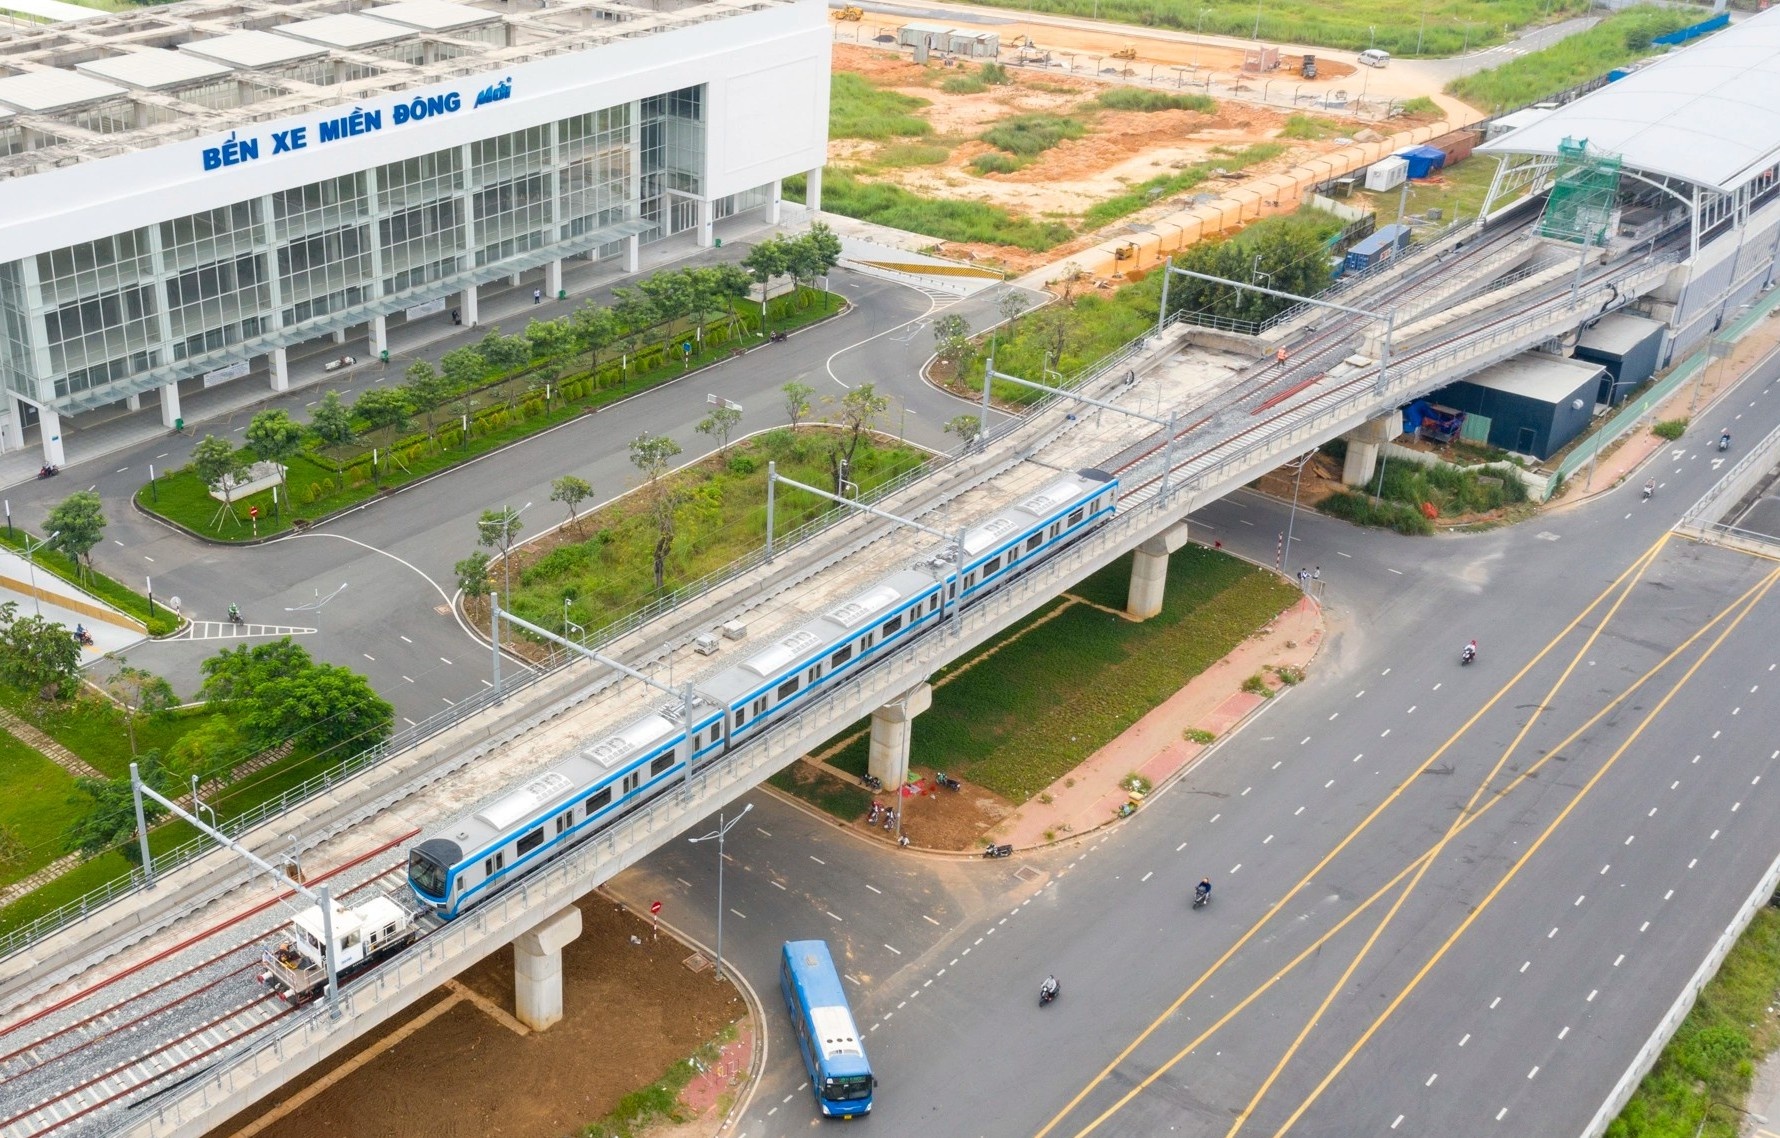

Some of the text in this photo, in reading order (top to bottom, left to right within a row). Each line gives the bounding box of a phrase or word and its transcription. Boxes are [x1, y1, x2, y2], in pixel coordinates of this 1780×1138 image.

[202, 77, 512, 171] BẾN XE MIỀN ĐÔNG Mới
